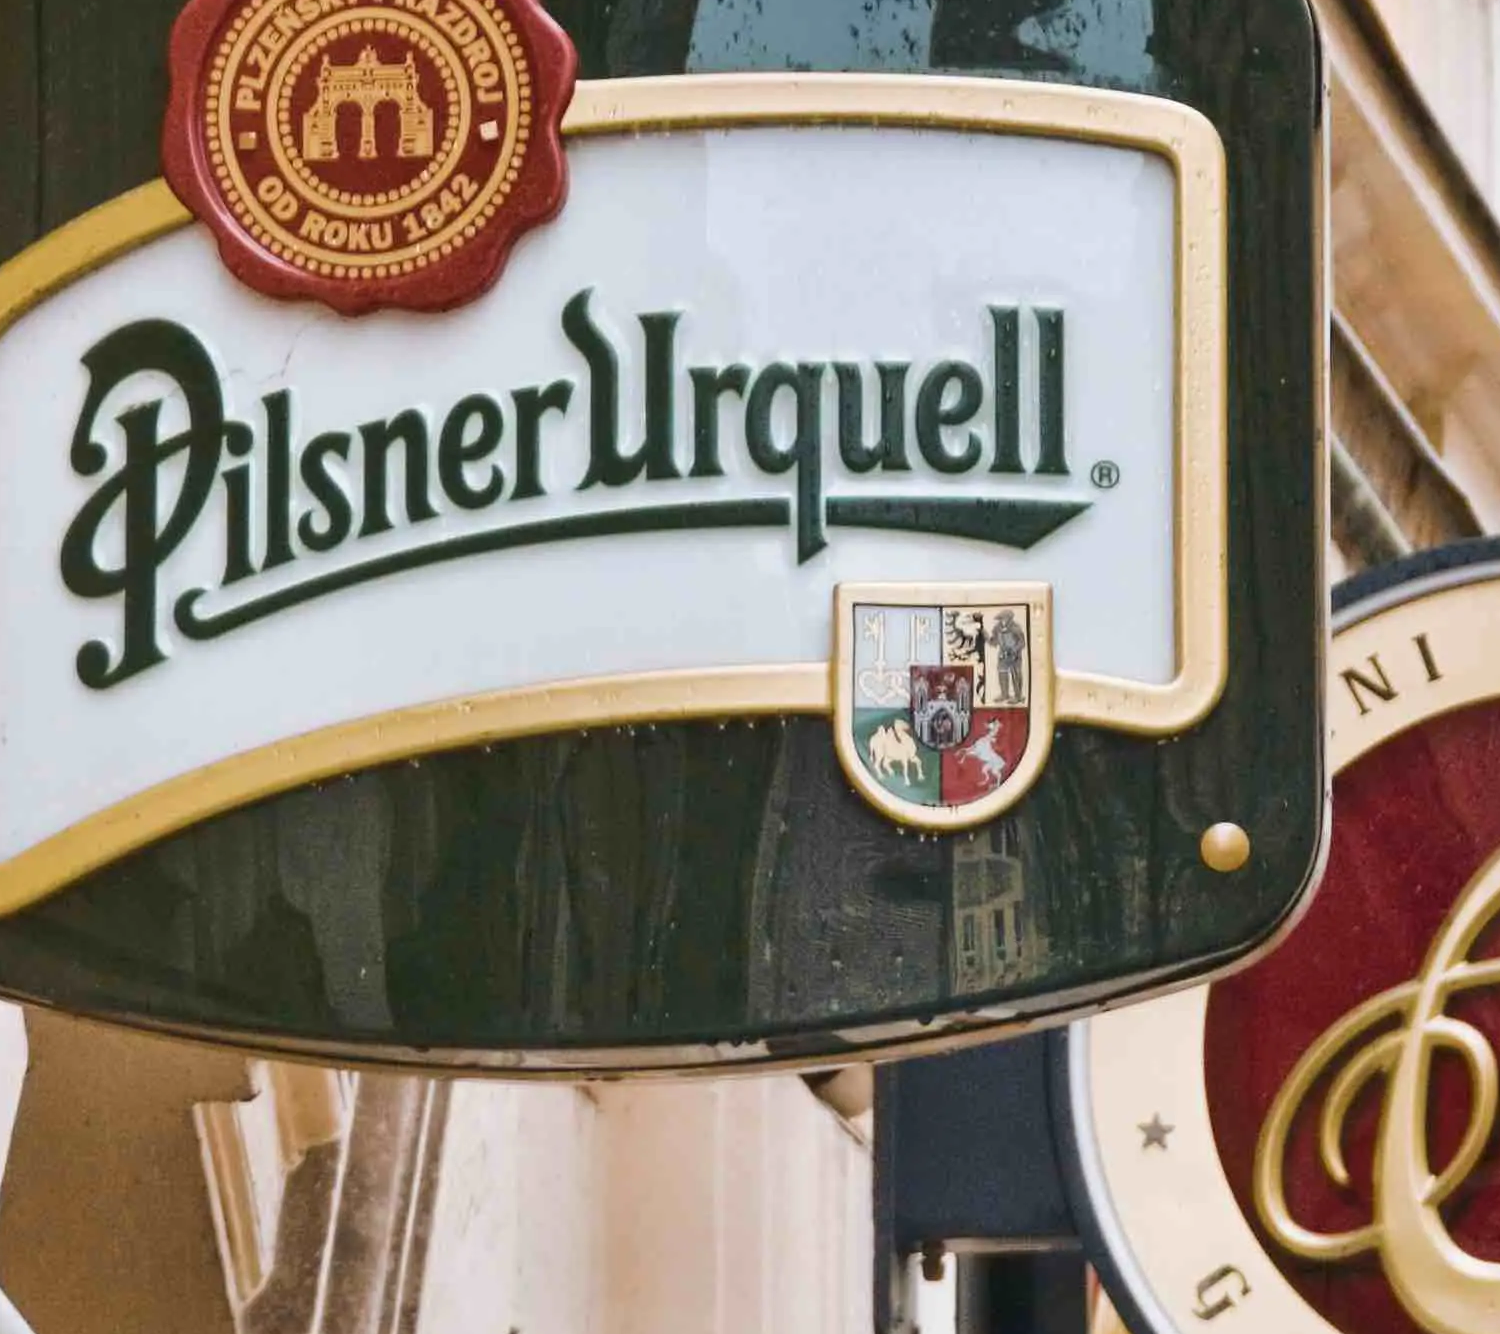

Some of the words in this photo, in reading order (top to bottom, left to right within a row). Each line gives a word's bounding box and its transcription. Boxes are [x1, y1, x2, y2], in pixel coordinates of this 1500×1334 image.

[257, 175, 298, 220] OD
[300, 213, 393, 251] ROKU
[402, 173, 479, 243] 1842
[60, 318, 574, 690] Pilsner
[561, 287, 1071, 566] Urquell
